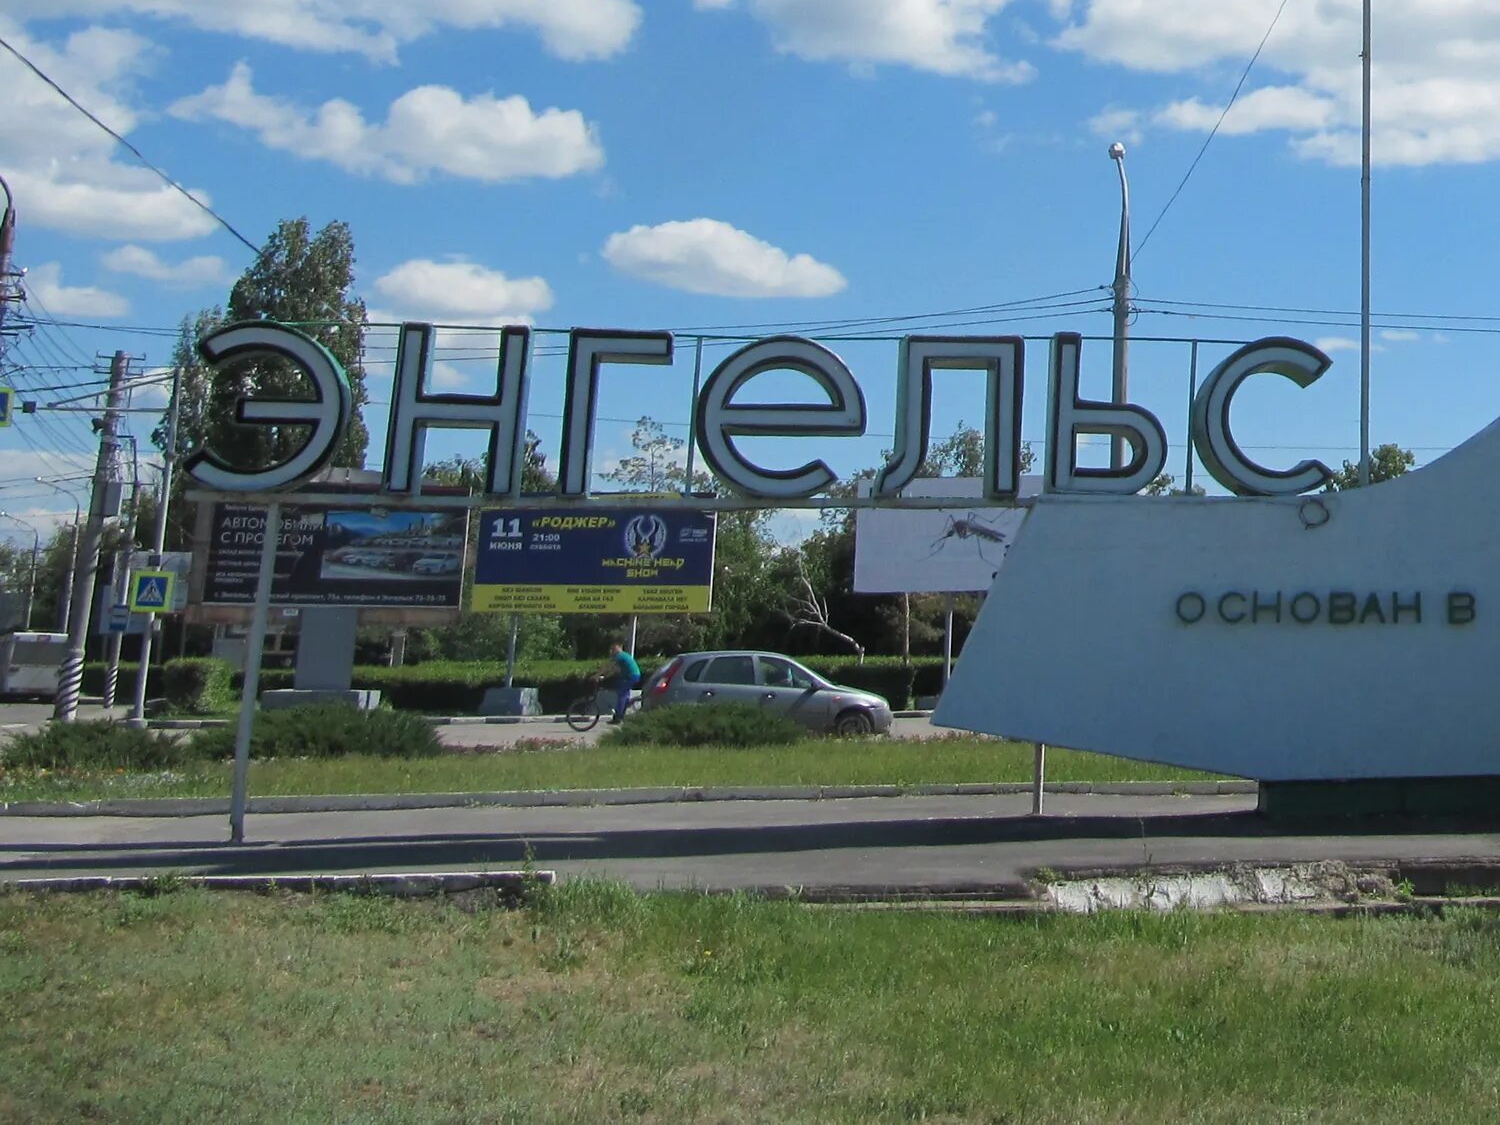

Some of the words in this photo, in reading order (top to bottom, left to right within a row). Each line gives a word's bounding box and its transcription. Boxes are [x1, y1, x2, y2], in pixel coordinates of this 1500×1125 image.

[490, 517, 523, 538] 11
[531, 516, 616, 530] «РОДЖЕР»
[220, 531, 231, 544] С
[532, 533, 561, 542] 21:00
[489, 541, 523, 550] ИЮНЯ
[1175, 590, 1422, 624] ОСНОВАН
[1447, 591, 1477, 625] В
